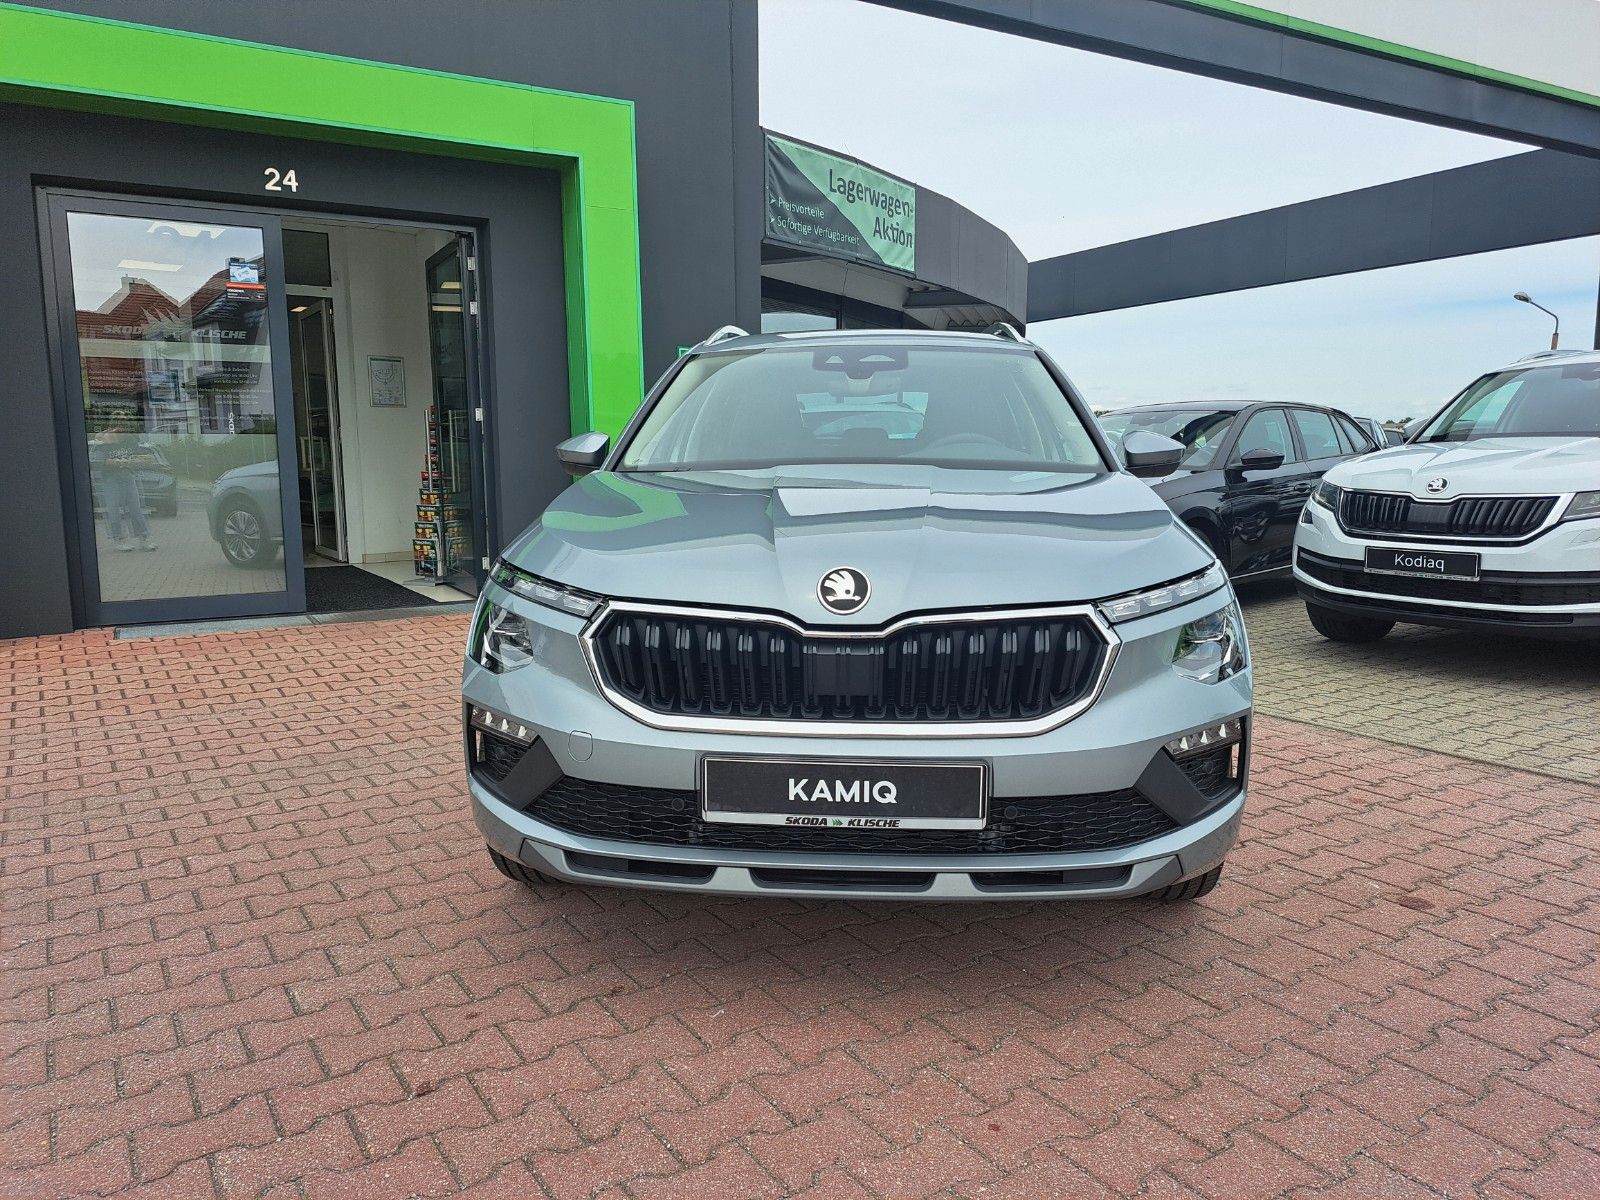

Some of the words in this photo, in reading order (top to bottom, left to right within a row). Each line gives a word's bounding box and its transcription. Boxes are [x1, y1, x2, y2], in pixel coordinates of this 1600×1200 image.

[263, 167, 299, 192] 24
[778, 196, 825, 219] Preisvorteile
[777, 215, 812, 236] Sofortige
[813, 224, 860, 246] Verfügbarkeit
[872, 216, 913, 249] Aktion
[192, 329, 247, 340] KLISCHE
[1394, 553, 1445, 573] Kodiaq
[787, 777, 898, 804] KAMIQ
[847, 818, 901, 828] KLISCHE
